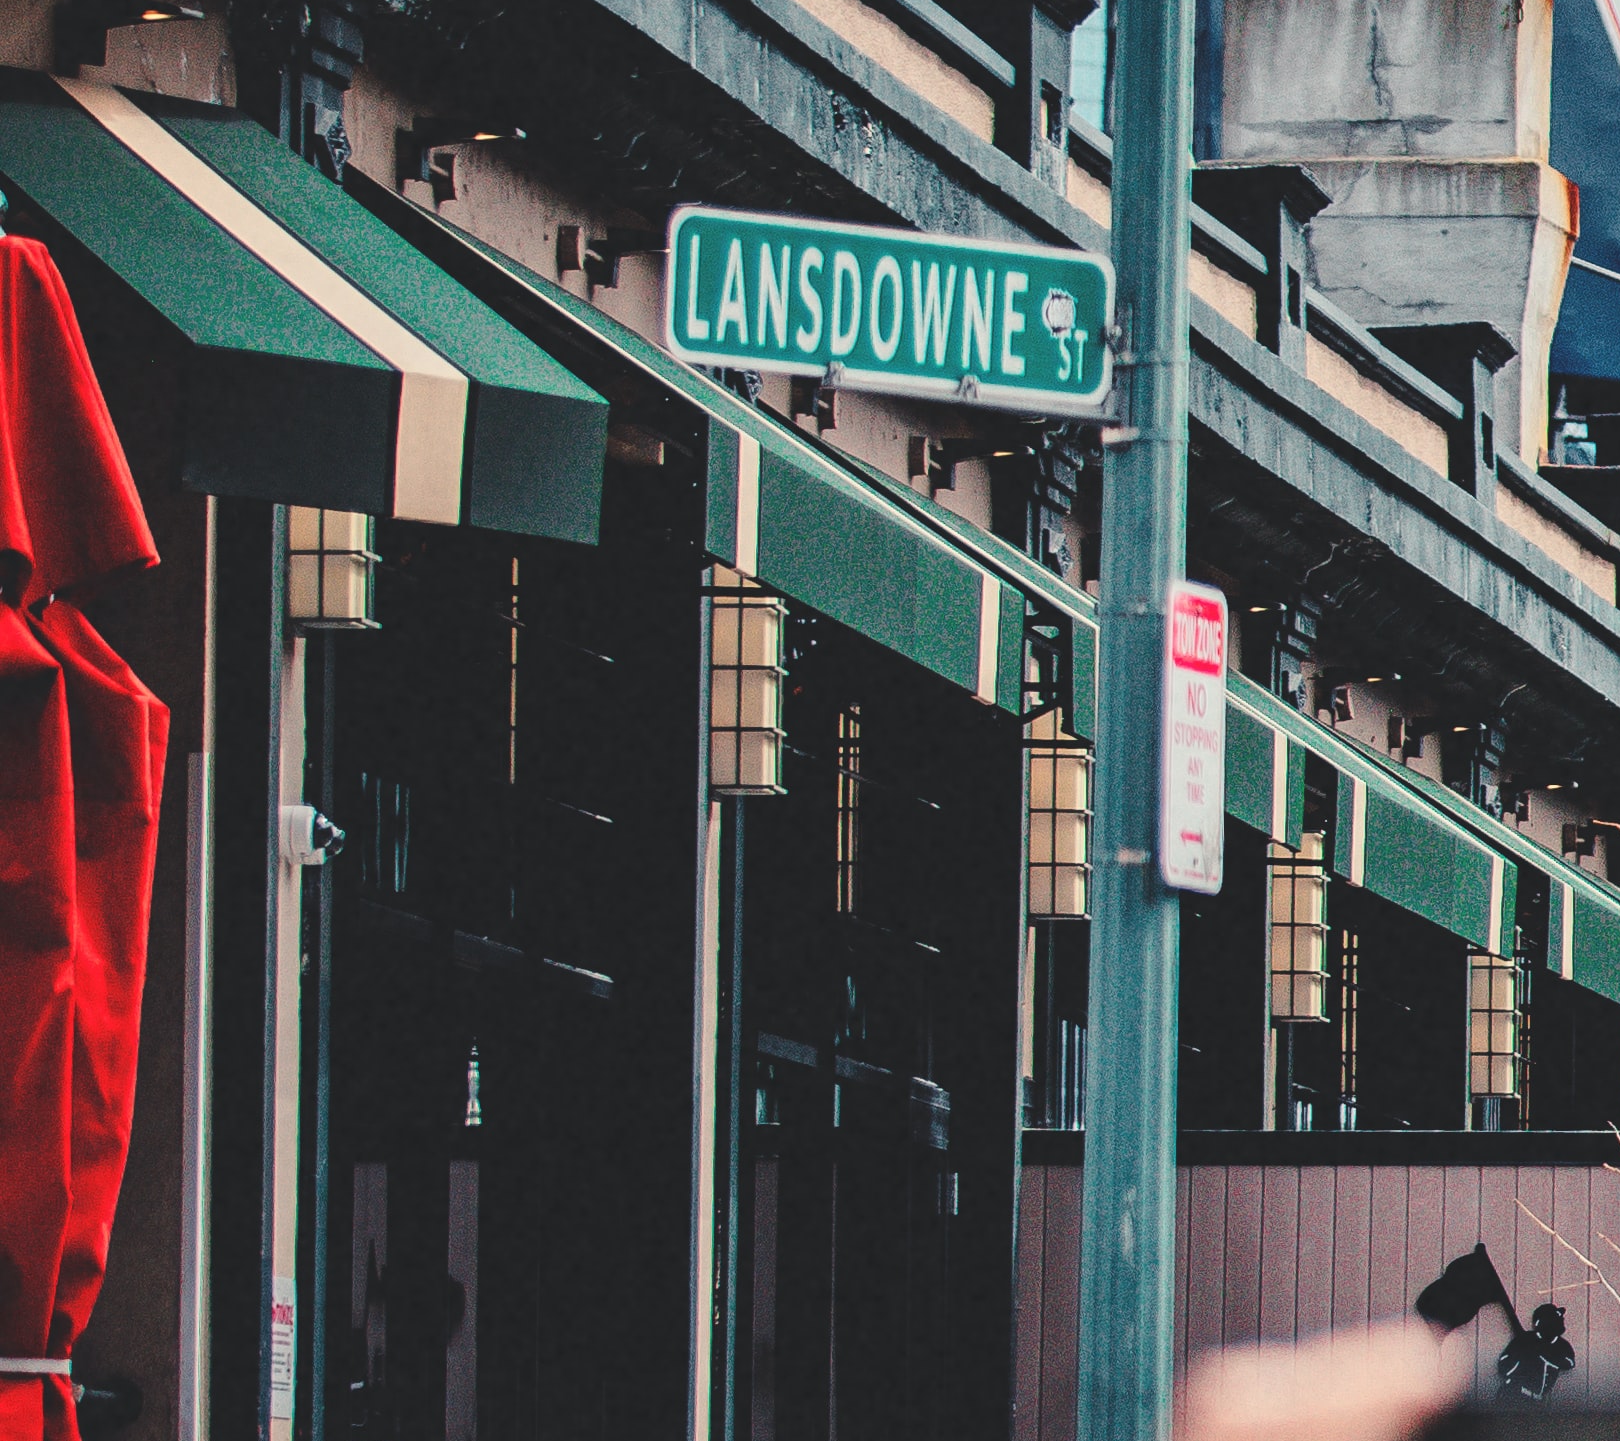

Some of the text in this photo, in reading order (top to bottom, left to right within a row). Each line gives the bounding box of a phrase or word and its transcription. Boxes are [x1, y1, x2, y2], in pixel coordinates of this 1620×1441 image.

[686, 233, 1089, 382] LANSDOWNE ST
[1176, 611, 1222, 664] TOW ZONE
[1187, 680, 1208, 718] NO
[1174, 720, 1219, 754] STOPPING
[1187, 756, 1205, 777] ANY
[1186, 781, 1206, 805] TIME
